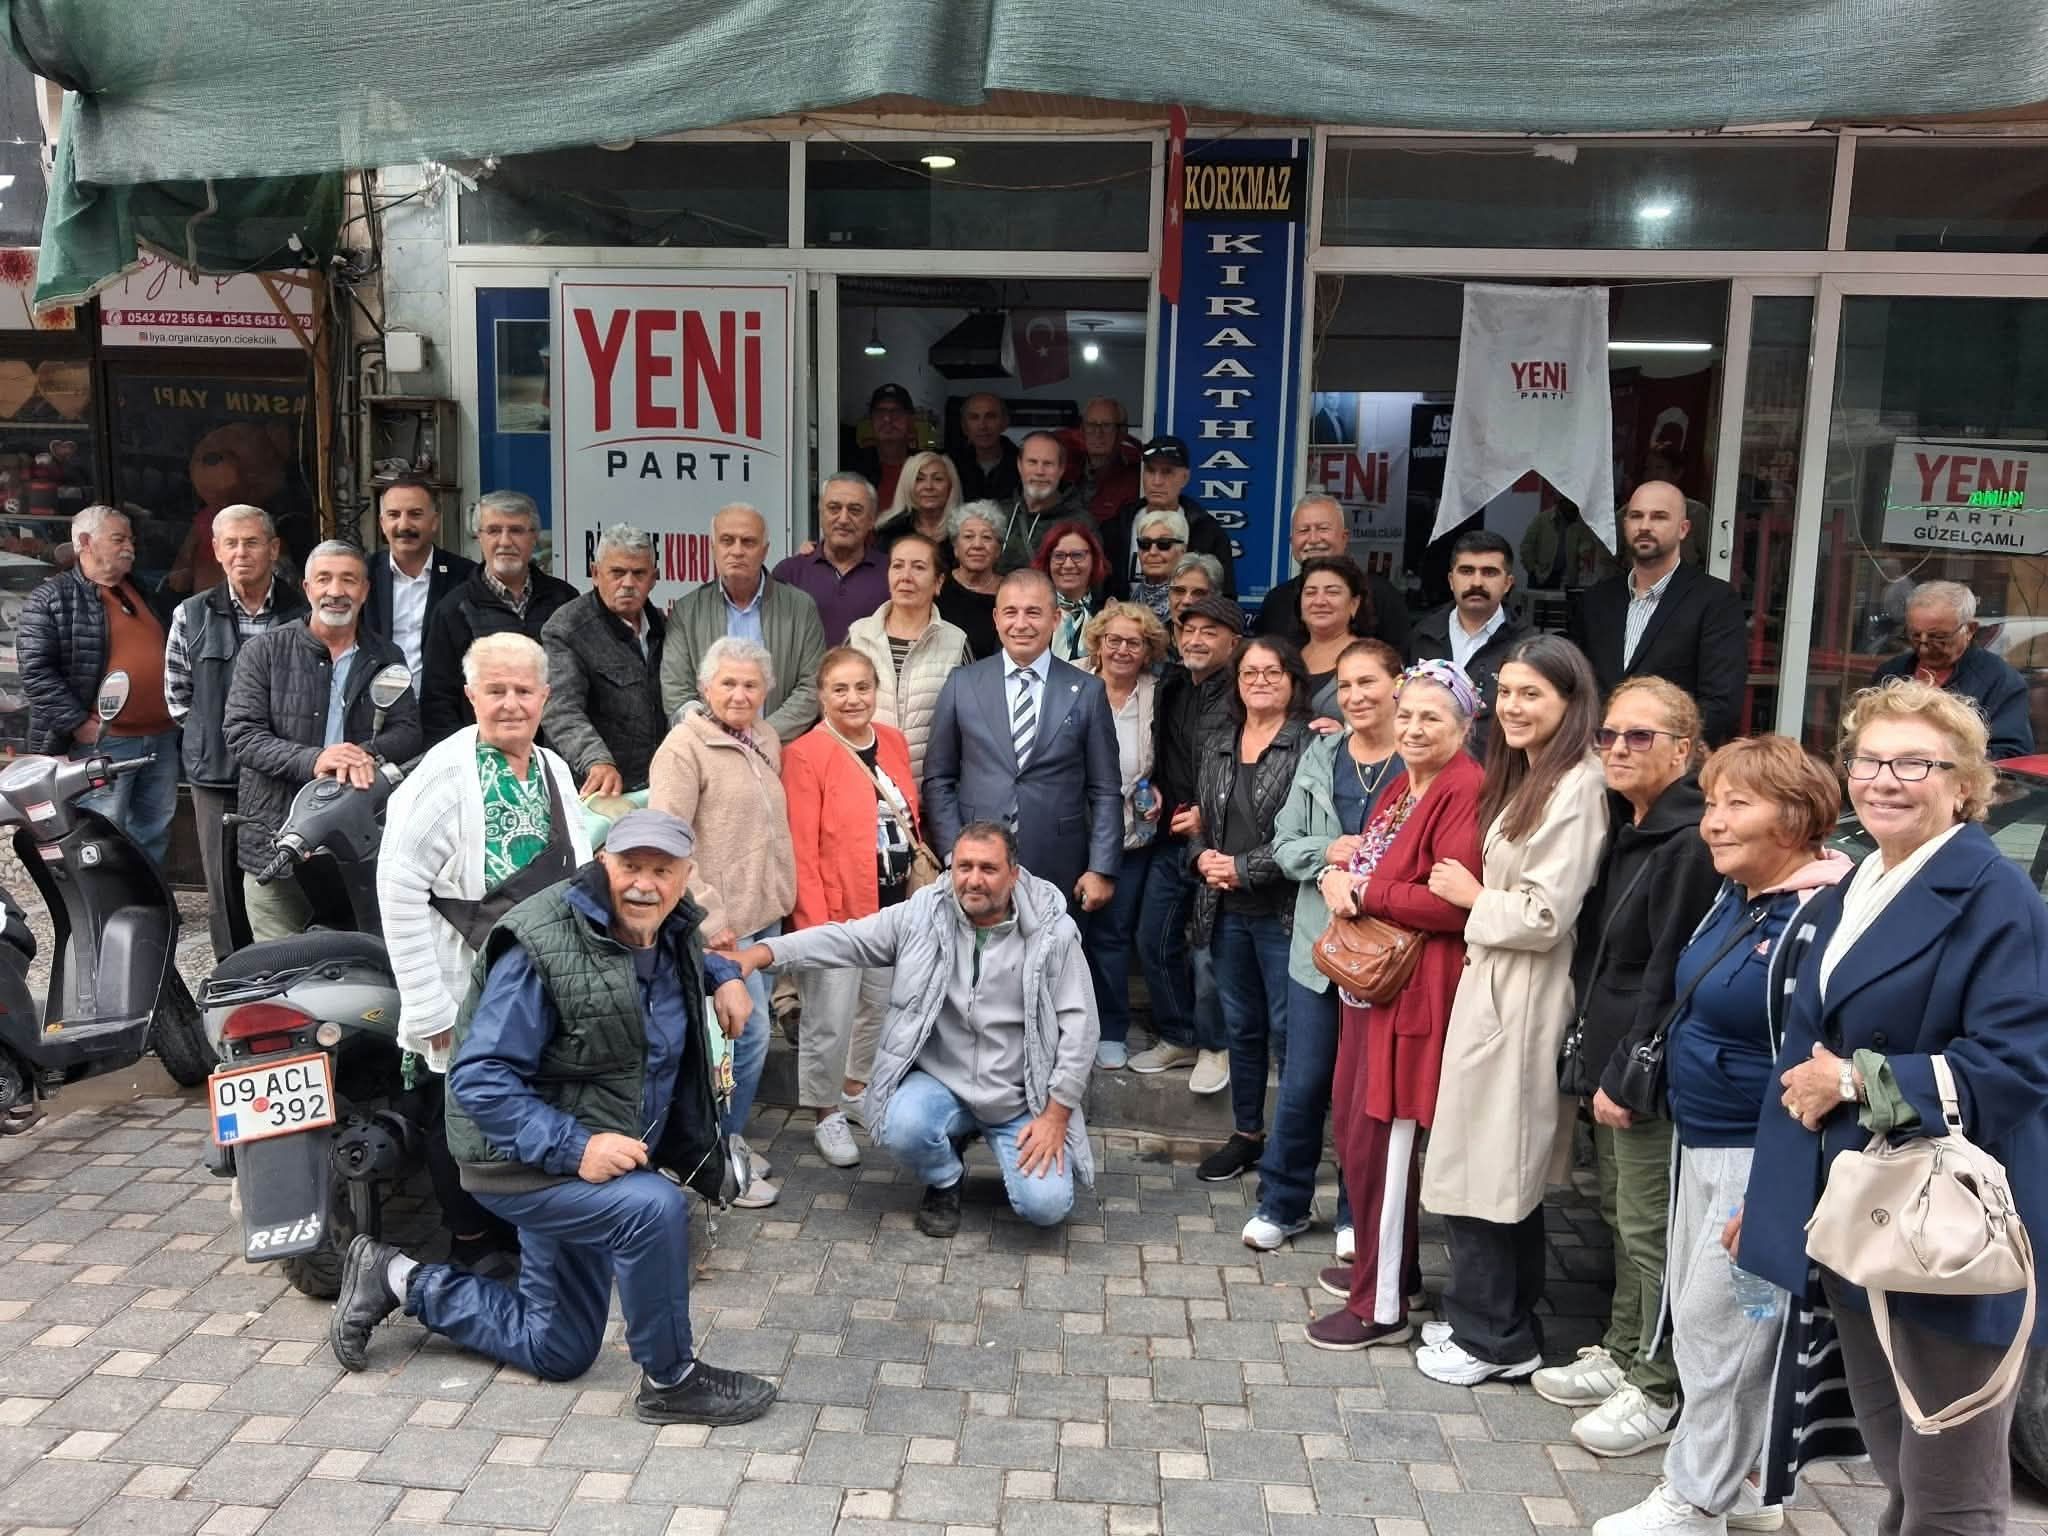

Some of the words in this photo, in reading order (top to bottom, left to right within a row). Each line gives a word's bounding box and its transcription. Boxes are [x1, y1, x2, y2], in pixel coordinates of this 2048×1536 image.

[1184, 165, 1292, 210] KORKMAZ
[128, 312, 155, 324] 0542
[159, 313, 178, 324] 472
[181, 313, 195, 325] 56
[198, 314, 213, 325] 64
[223, 314, 252, 325] 0543
[255, 315, 277, 326] 643
[1913, 525, 2025, 547] GÜZELÇAMLI
[665, 532, 719, 583] KURU
[219, 1078, 256, 1107] 09
[266, 1066, 322, 1098] ACL
[269, 1094, 326, 1127] 392
